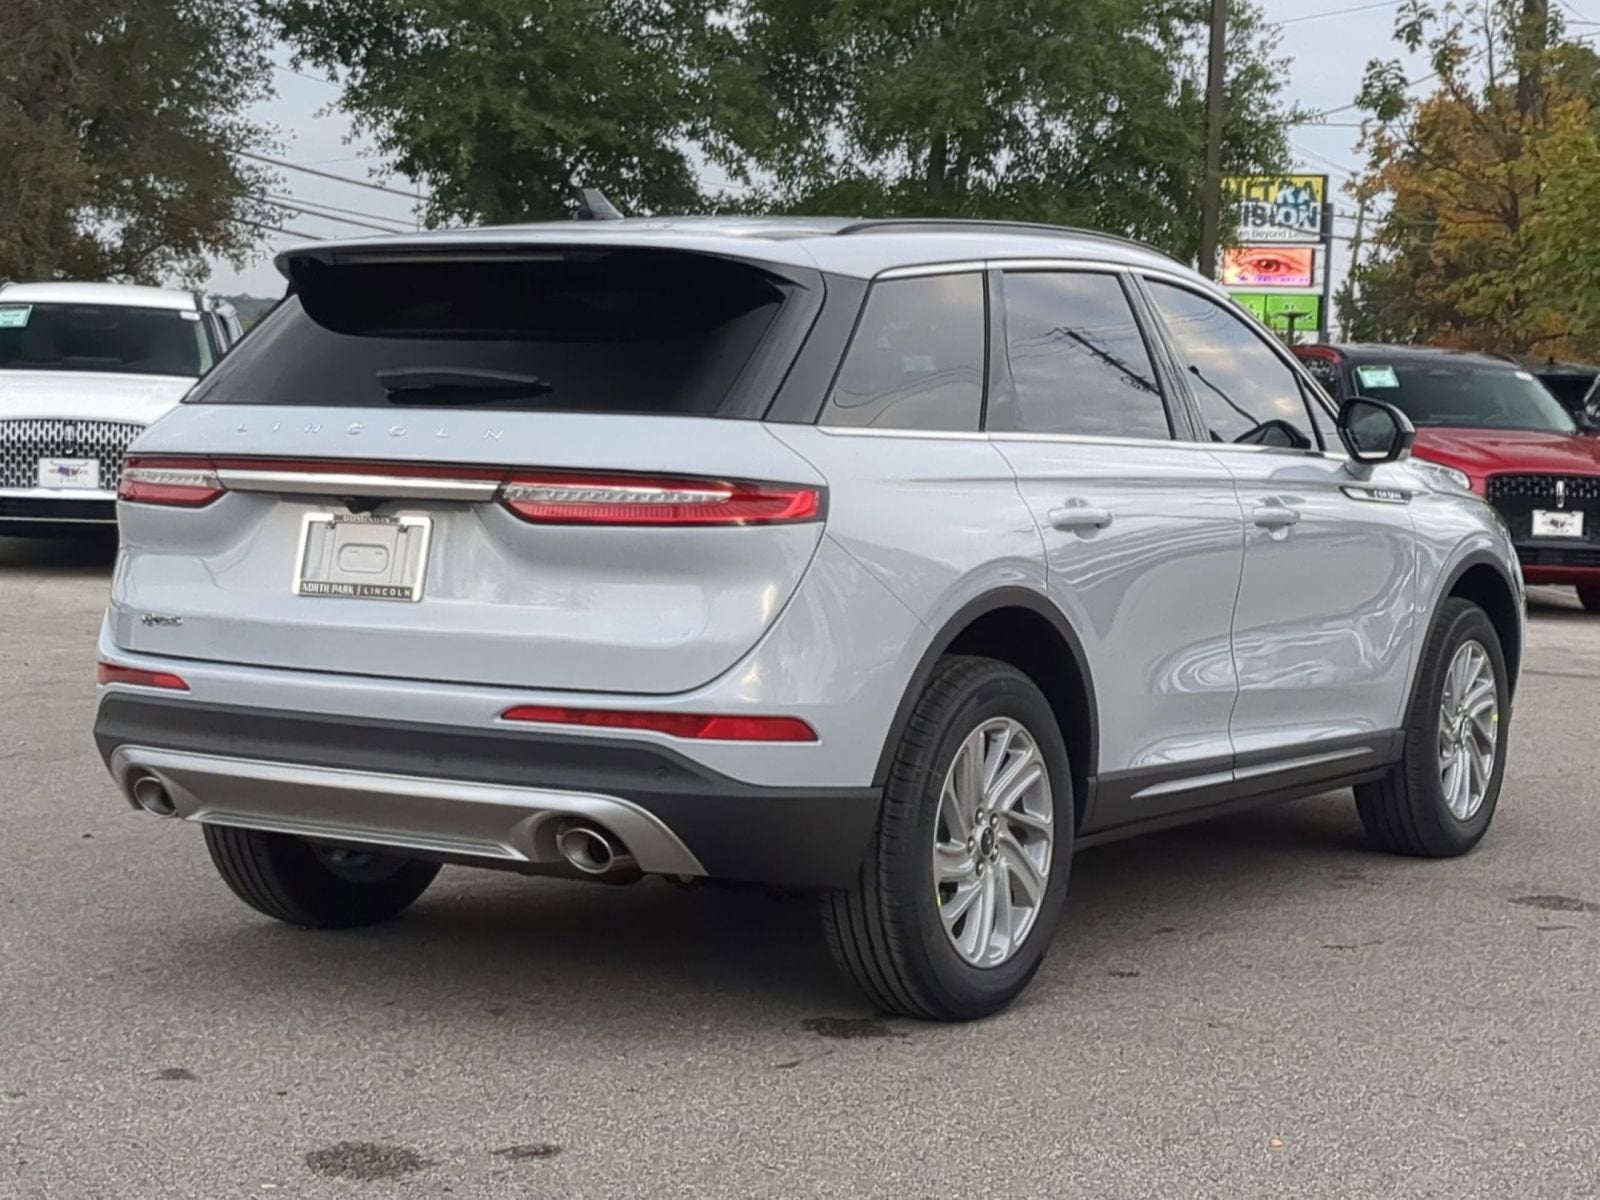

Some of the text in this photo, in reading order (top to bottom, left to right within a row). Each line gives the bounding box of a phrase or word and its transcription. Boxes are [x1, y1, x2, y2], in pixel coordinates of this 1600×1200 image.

[1233, 202, 1318, 228] ISION
[1252, 229, 1286, 240] Beyond
[236, 422, 504, 441] LINCOLN
[301, 582, 412, 598] NORTH PARK LINCOLN
